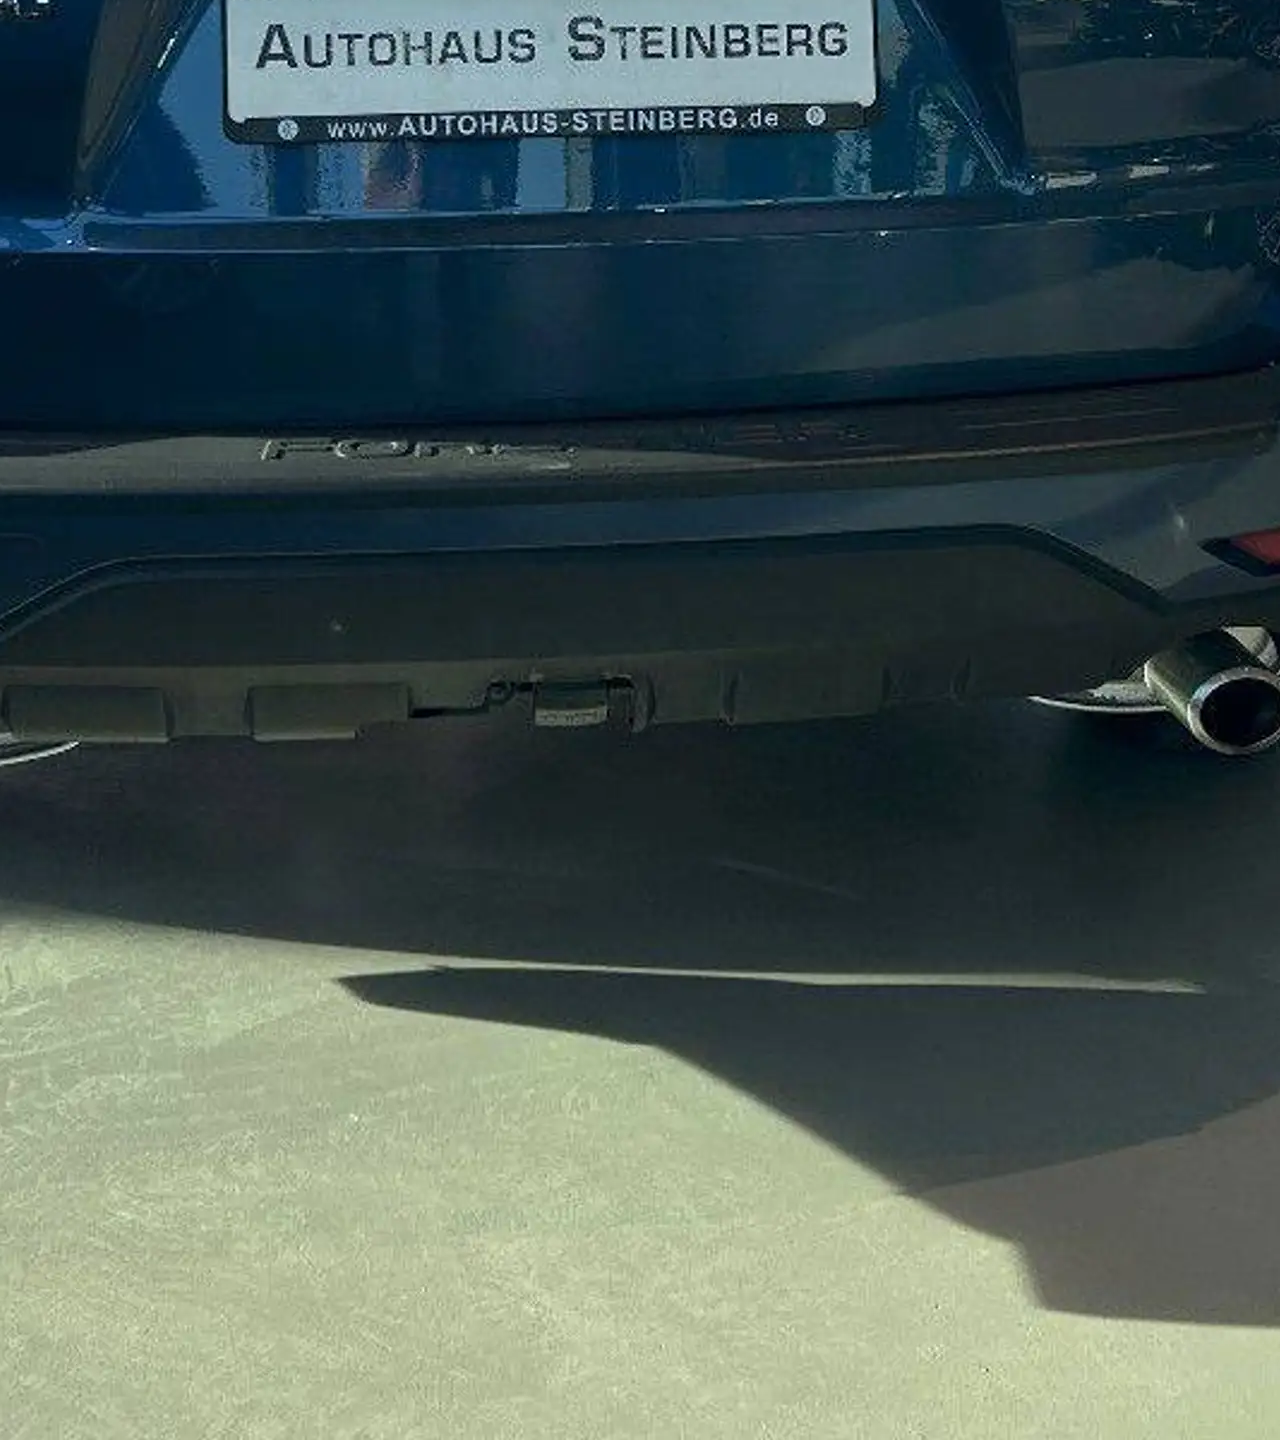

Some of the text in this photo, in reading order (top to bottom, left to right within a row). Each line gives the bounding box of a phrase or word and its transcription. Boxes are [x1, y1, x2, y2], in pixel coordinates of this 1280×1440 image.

[255, 15, 850, 69] AUTOHAUS STEINBERG
[327, 108, 779, 139] www.AUTOHAUS-STEINBERG.de
